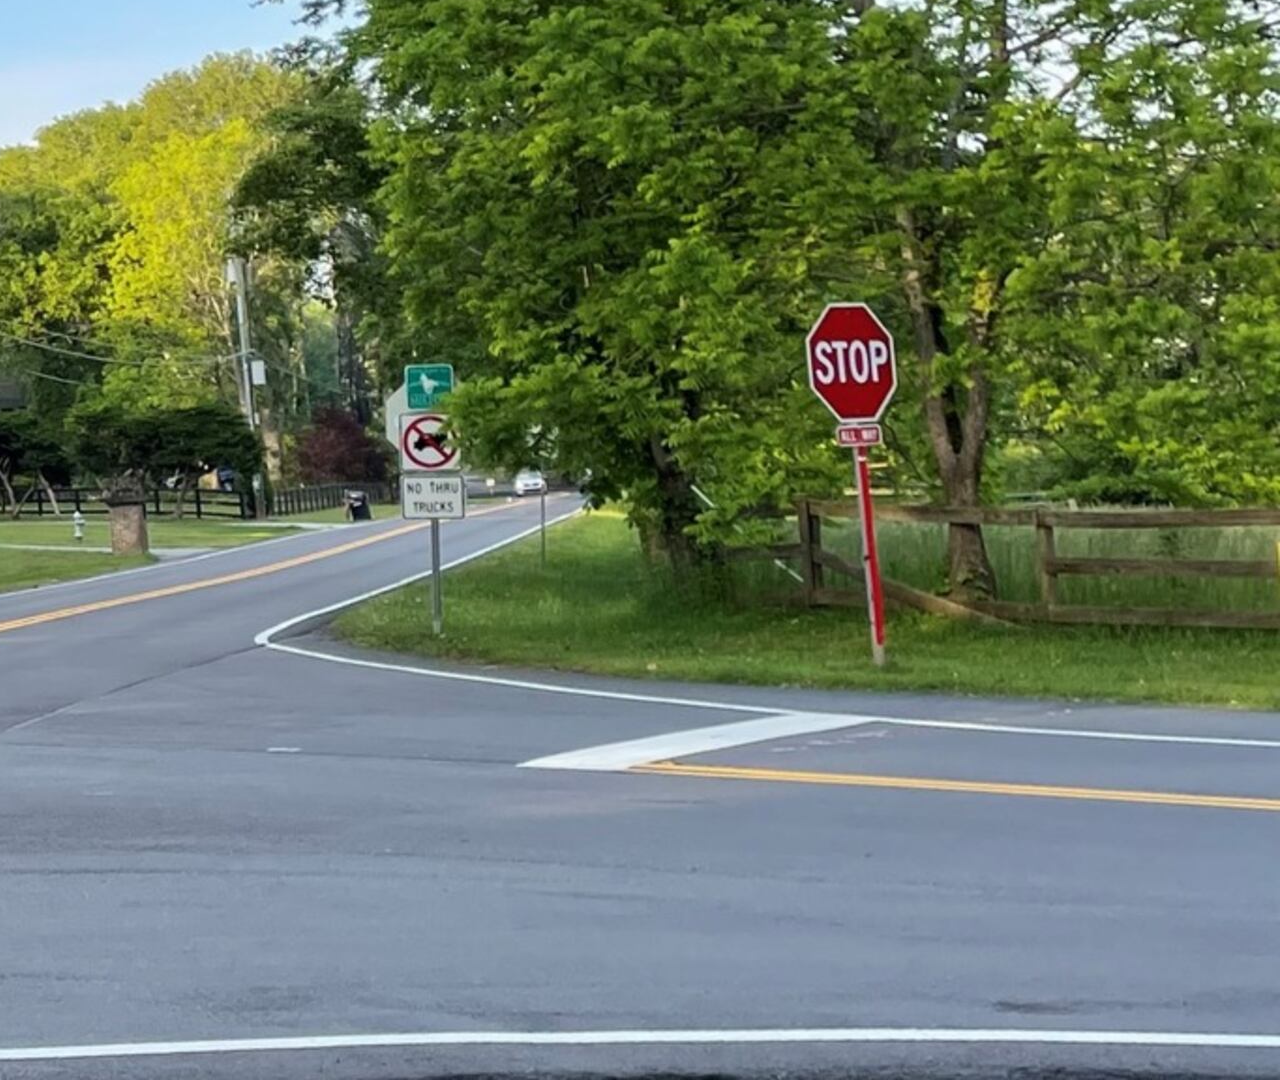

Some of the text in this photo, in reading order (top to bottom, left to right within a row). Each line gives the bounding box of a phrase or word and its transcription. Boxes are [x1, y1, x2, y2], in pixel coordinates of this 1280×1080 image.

[814, 338, 889, 385] STOP
[406, 481, 459, 494] NO THRU
[413, 501, 455, 513] TRUCKS
